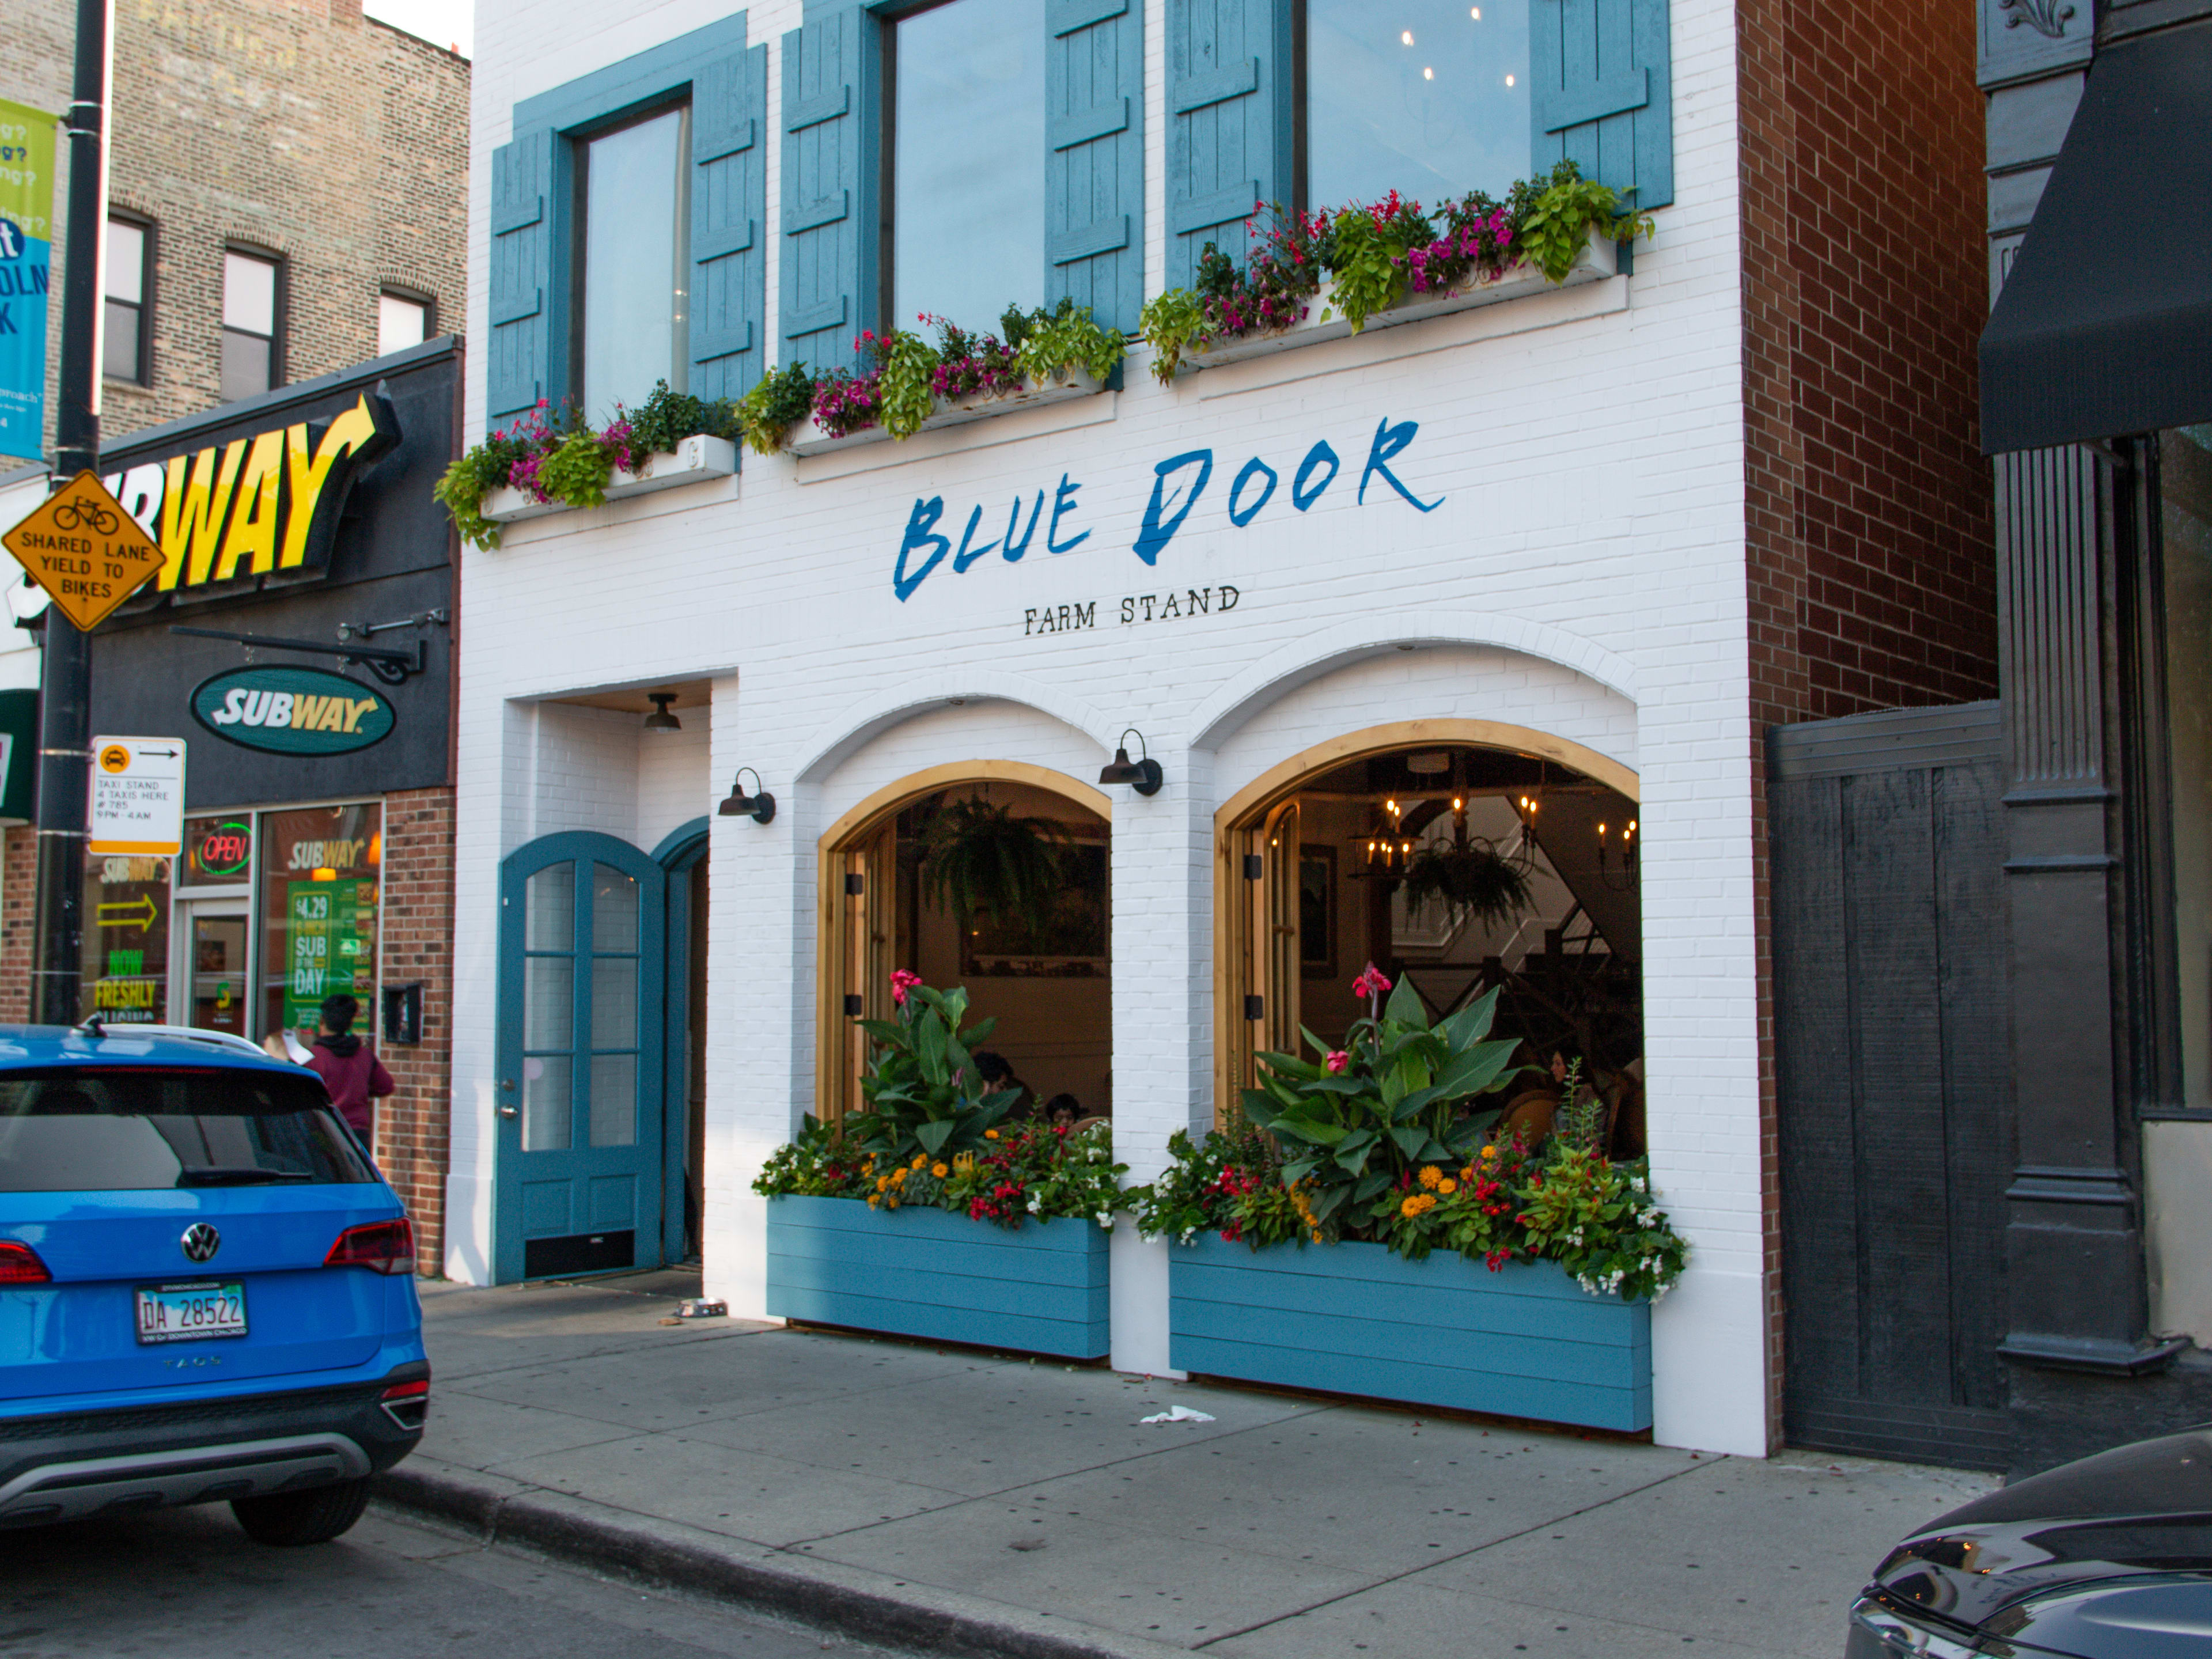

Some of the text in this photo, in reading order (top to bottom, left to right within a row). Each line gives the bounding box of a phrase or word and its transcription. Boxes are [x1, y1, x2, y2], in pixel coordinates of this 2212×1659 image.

[6, 392, 376, 620] BWAY
[894, 416, 1446, 602] BLUE DOOR
[22, 532, 150, 561] SHARED LANE
[41, 556, 124, 578] YIELD TO
[62, 579, 112, 598] BIKES
[1025, 585, 1240, 635] FARM STAND
[211, 688, 379, 733] SUBWAY
[99, 780, 160, 790] TAXI STAND
[110, 791, 138, 799] TAXIS
[142, 792, 169, 800] HERE
[109, 801, 128, 809] 785
[204, 835, 247, 861] OPEN
[288, 838, 365, 870] SUBWAY
[296, 896, 327, 919] $4.29
[296, 936, 326, 957] SUB
[108, 950, 143, 976] NOW
[94, 980, 156, 1007] FRESHLY
[294, 968, 324, 995] DAY
[143, 1296, 241, 1329] DA 28522
[164, 1356, 222, 1369] TAOS
